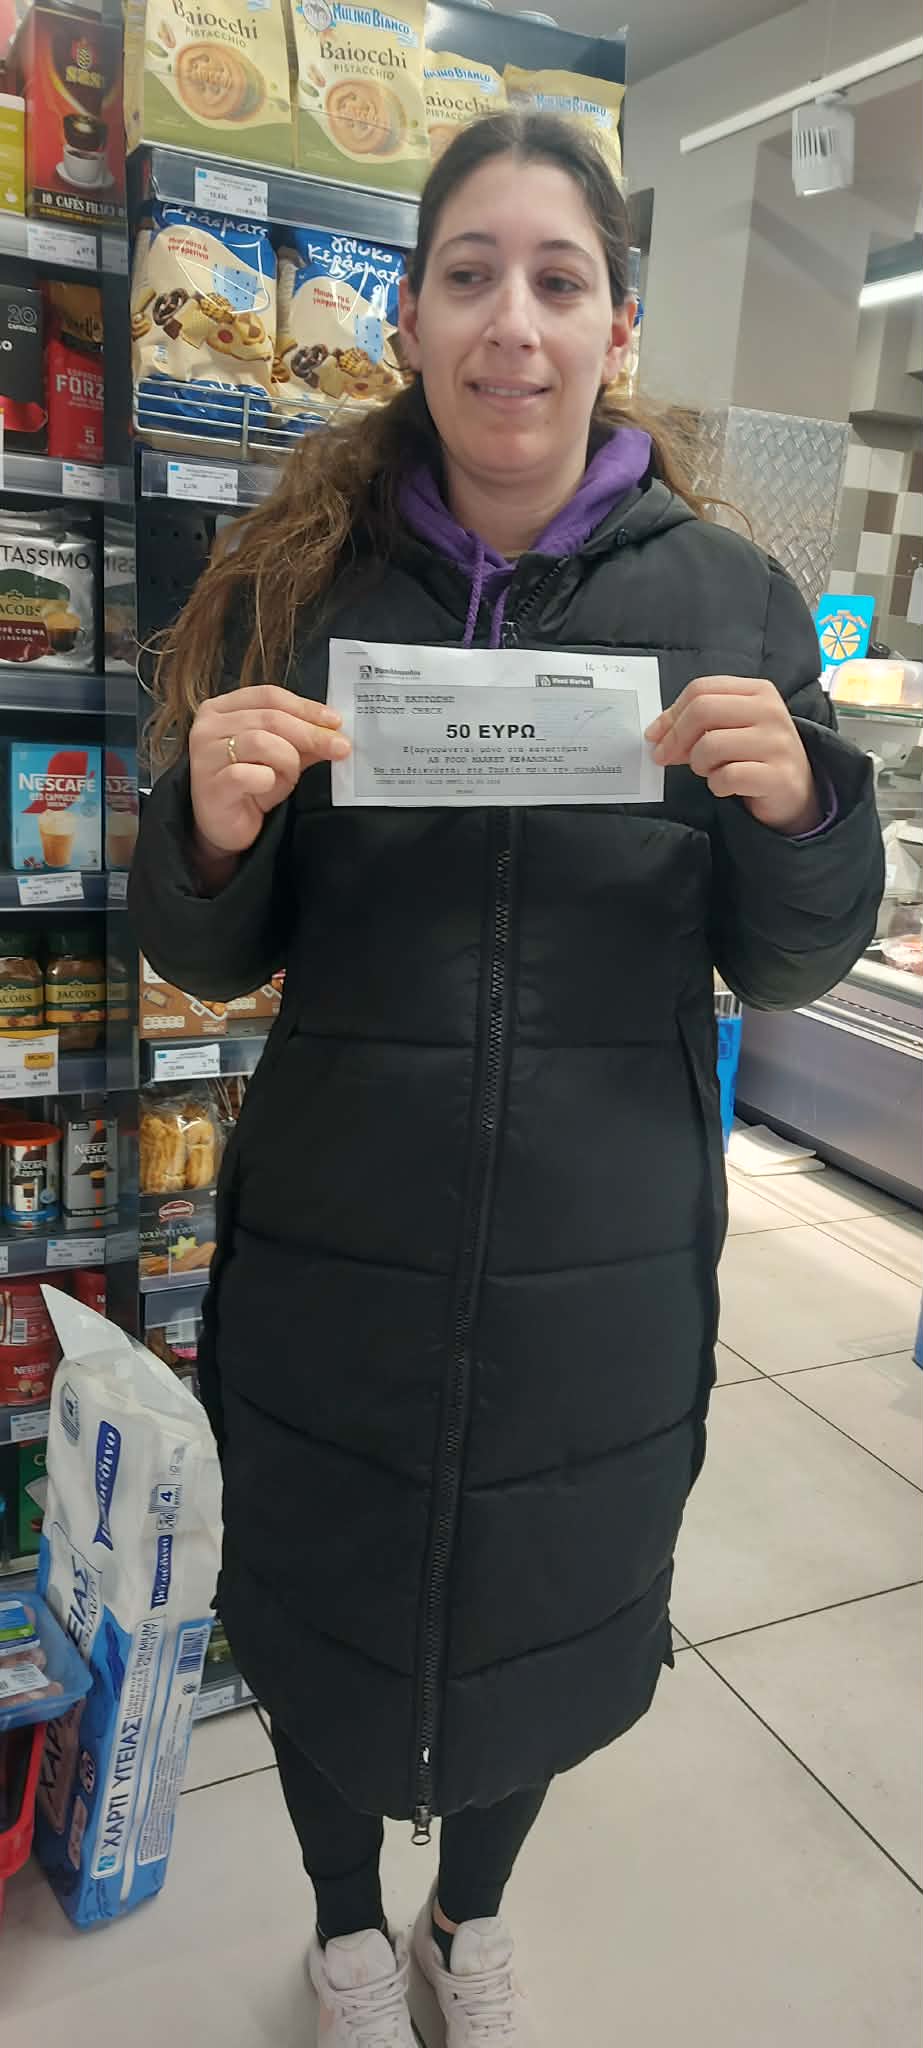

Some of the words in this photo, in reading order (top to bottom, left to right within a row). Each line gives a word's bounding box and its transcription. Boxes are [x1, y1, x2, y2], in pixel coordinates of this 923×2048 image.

[172, 0, 258, 39] Baiocchi
[332, 3, 371, 25] MULINO
[372, 8, 410, 34] BIANCO
[185, 25, 247, 48] PISTACCHIO
[320, 41, 407, 68] Baiocchi
[334, 63, 395, 80] PISTACCHIO
[425, 91, 490, 113] aiocchi
[42, 193, 53, 205] 10
[8, 304, 38, 326] 20
[56, 374, 104, 400] FORZ
[85, 429, 95, 445] 5
[0, 545, 91, 570] TASSIMO
[0, 603, 41, 617] ACOBS
[357, 706, 405, 714] DISCOUNT
[446, 724, 471, 738] 50
[19, 769, 96, 793] NESCAFÉ
[56, 990, 97, 1001] JACOBS
[74, 1142, 108, 1154] NESC
[81, 1154, 109, 1164] AZER
[159, 1490, 173, 1503] 4
[66, 1556, 90, 1648] ΕΙΑΣ
[111, 1717, 142, 1789] ΥΓΕΙΑΣ
[102, 1794, 129, 1849] ΧΑΡΤΙ
